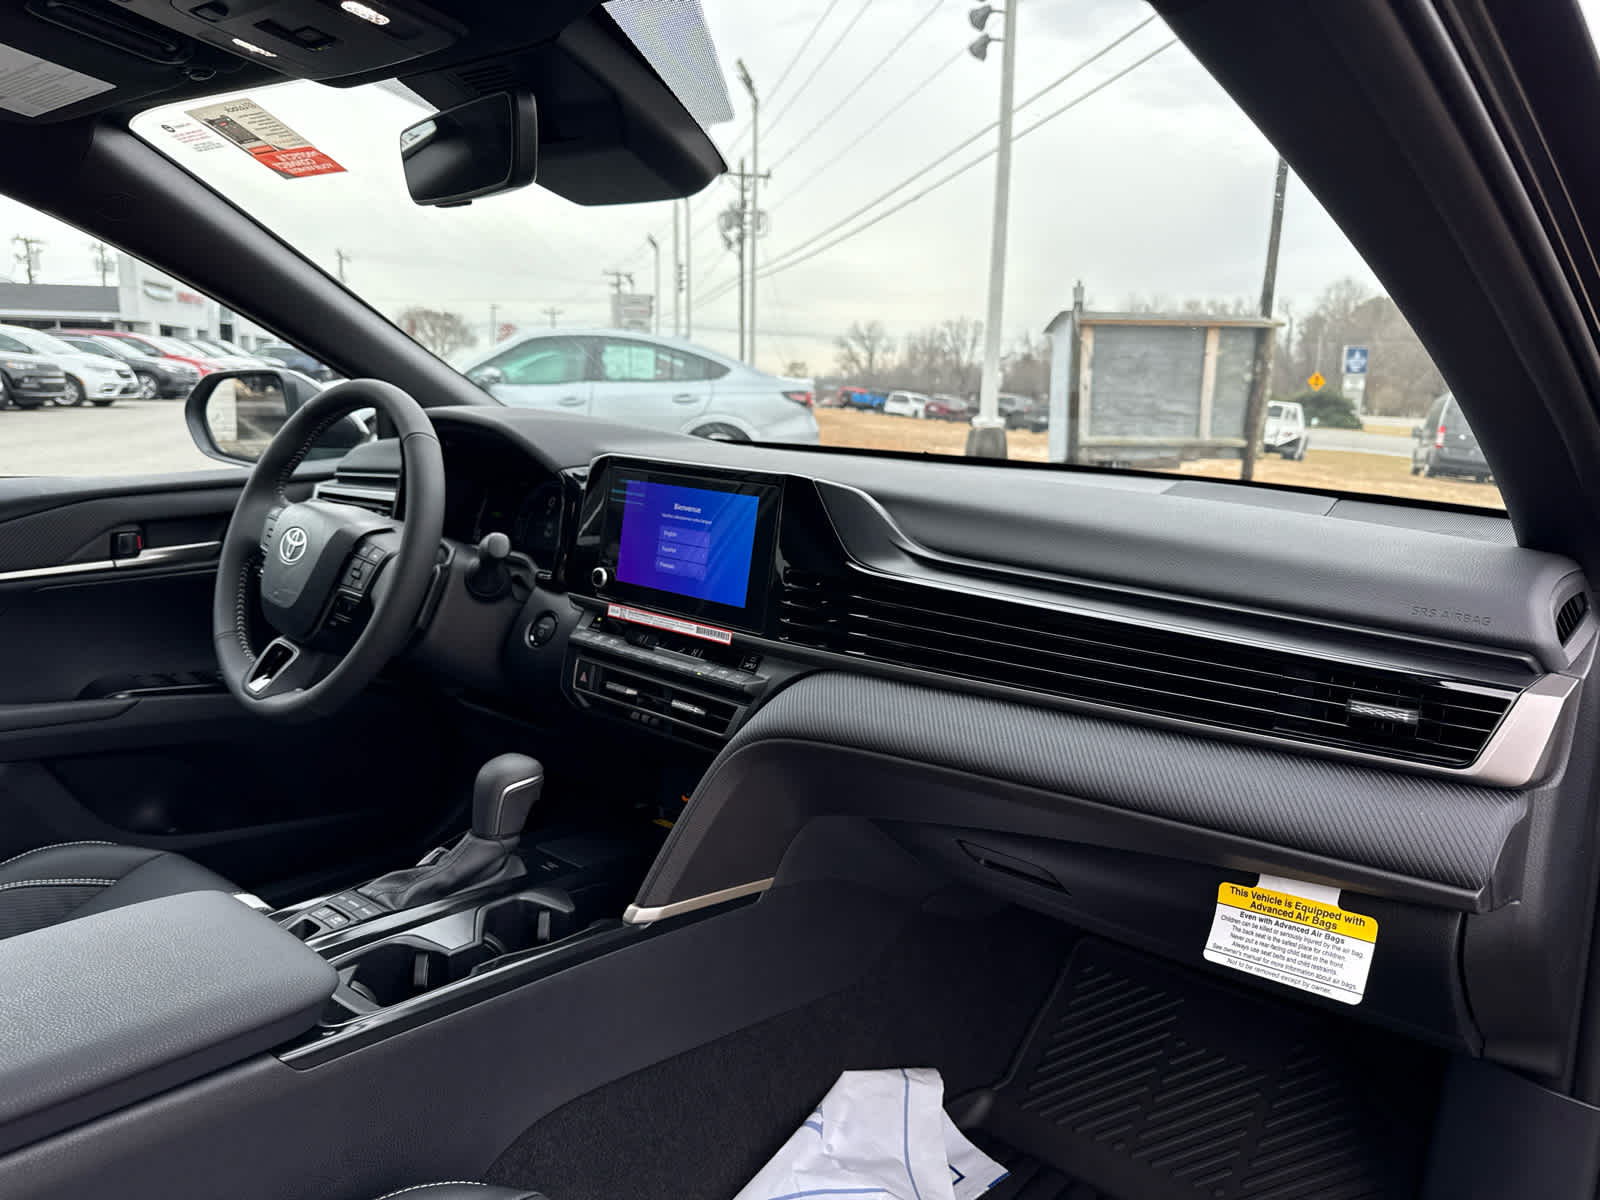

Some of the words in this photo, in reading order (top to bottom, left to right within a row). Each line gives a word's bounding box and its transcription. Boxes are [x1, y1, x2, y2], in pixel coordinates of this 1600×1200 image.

[1411, 606, 1437, 618] SRS
[1440, 609, 1492, 626] AIRBAG
[1230, 886, 1248, 898] This
[1251, 891, 1282, 906] Vehicle
[1284, 898, 1293, 908] is
[1294, 901, 1342, 921] Equipped
[1344, 915, 1365, 927] with
[1250, 901, 1294, 918] Advanced
[1295, 912, 1310, 922] Air
[1311, 916, 1337, 930] Bags
[1240, 911, 1257, 921] Even
[1259, 917, 1273, 925] with
[1274, 920, 1310, 935] Advanced
[1324, 933, 1345, 944] Bags
